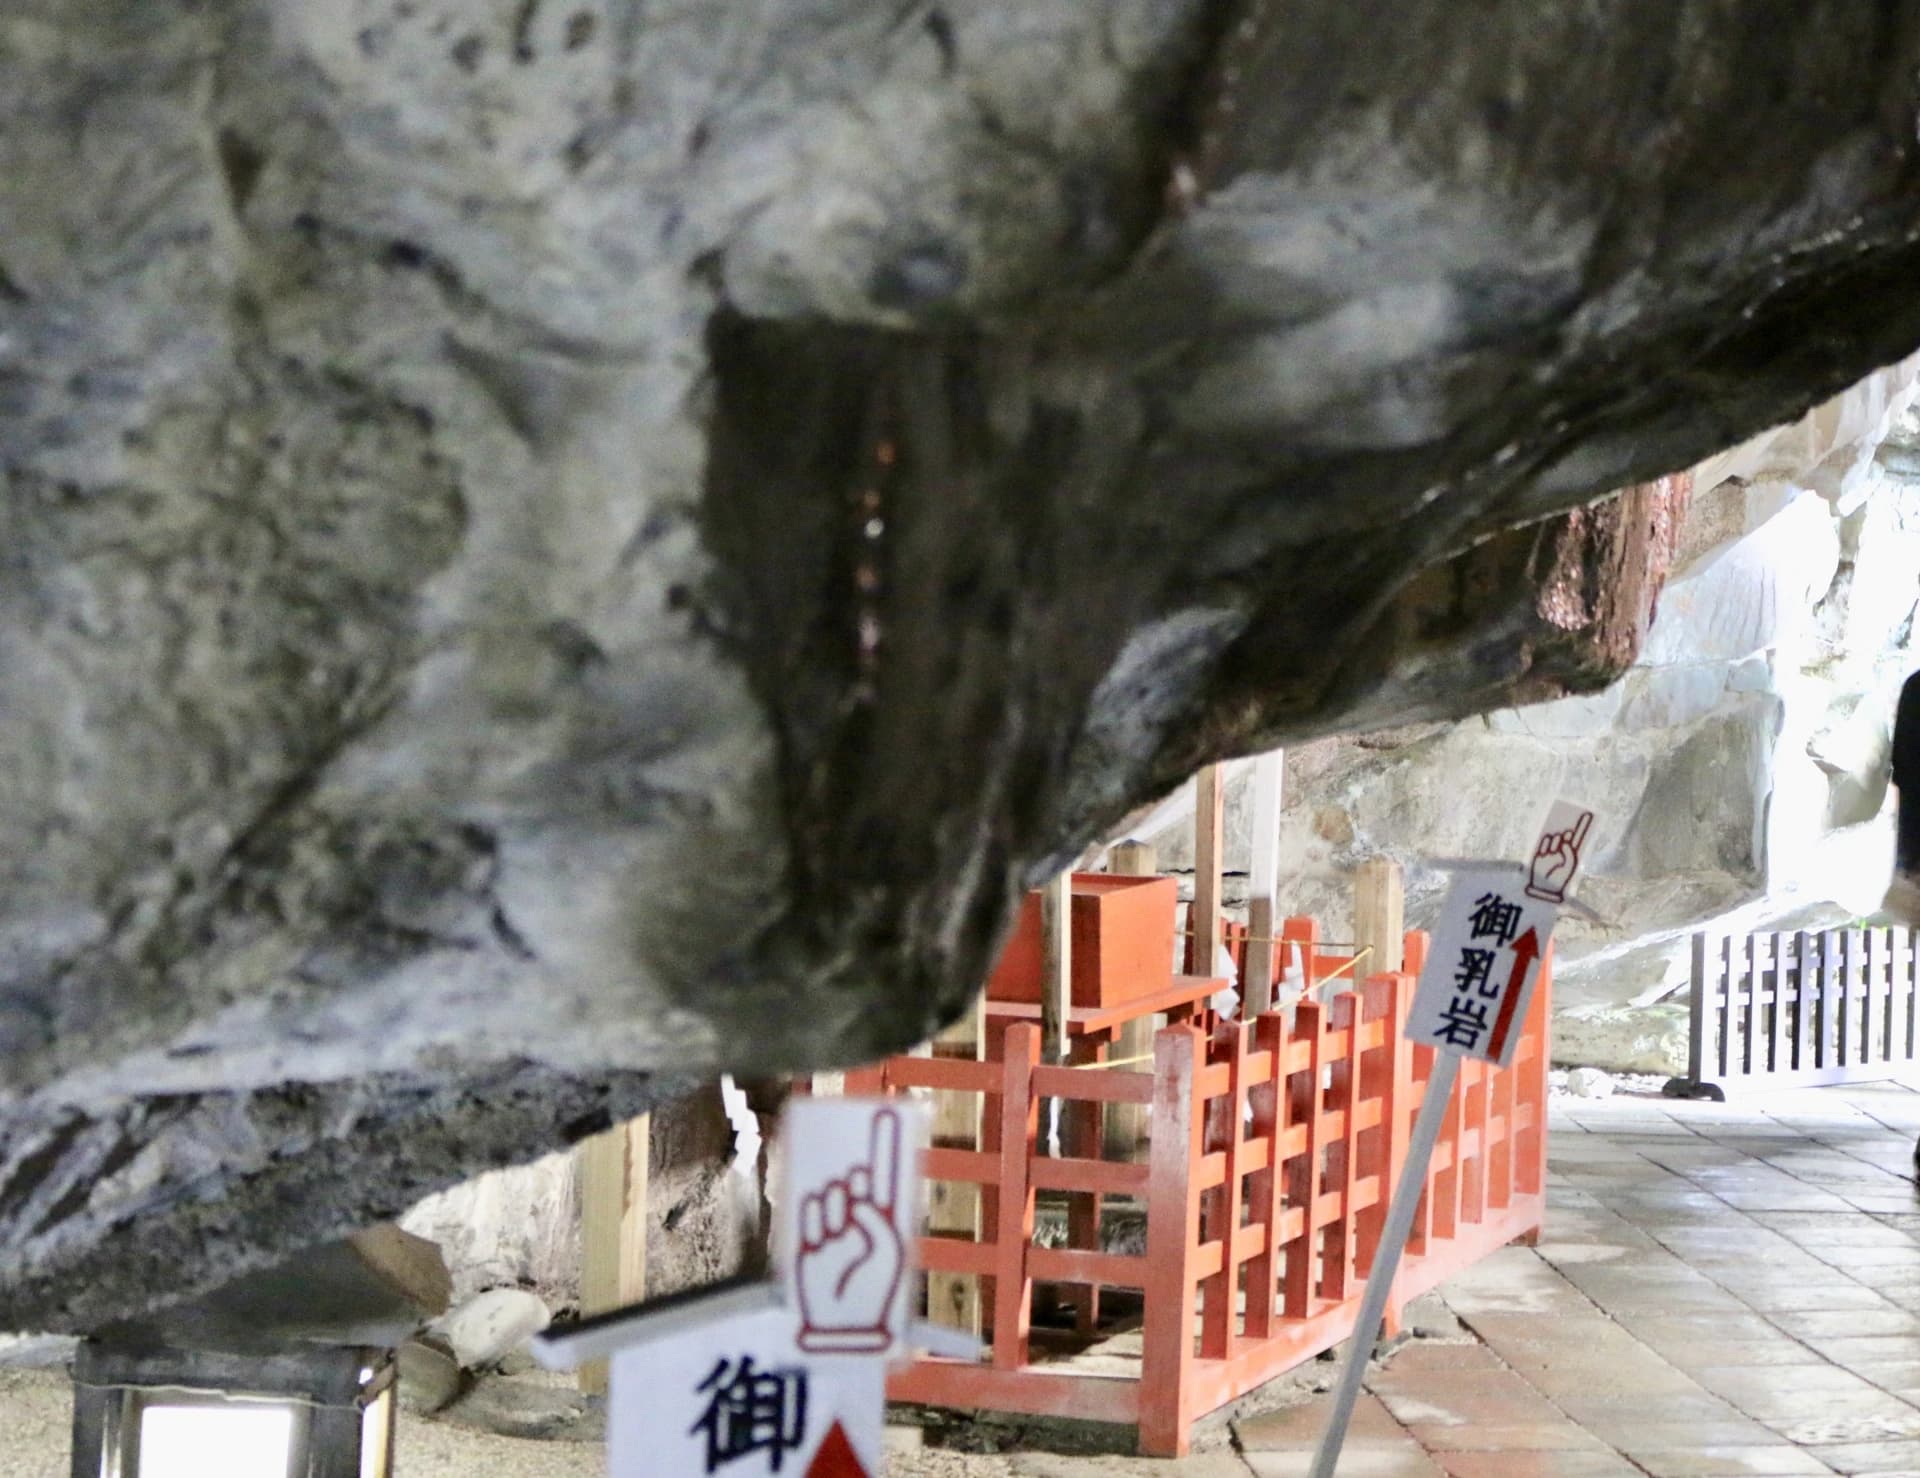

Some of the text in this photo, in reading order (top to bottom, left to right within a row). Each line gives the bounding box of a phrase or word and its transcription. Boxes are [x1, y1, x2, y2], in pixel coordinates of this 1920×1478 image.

[1433, 892, 1523, 1050] 御乳岩
[689, 1354, 810, 1475] 御
